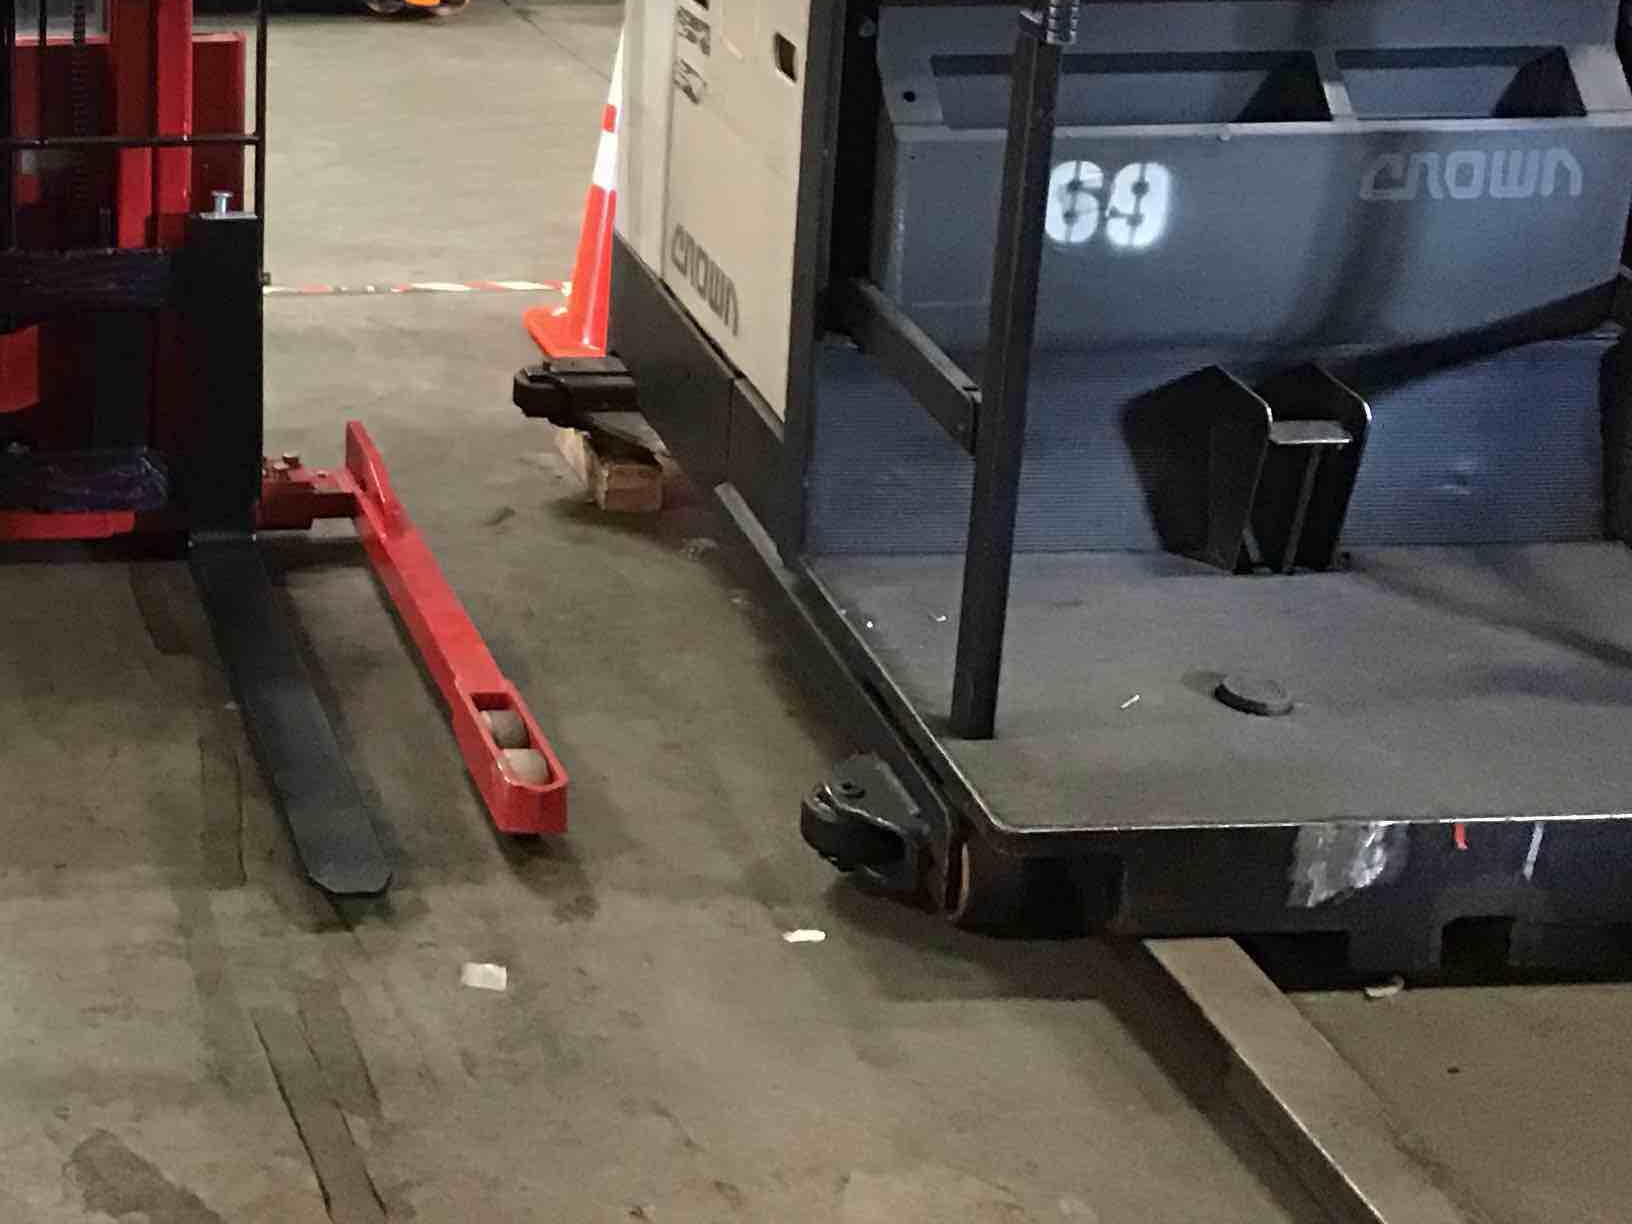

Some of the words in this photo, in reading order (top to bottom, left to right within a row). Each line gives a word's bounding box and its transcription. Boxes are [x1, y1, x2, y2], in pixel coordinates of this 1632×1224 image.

[1045, 160, 1170, 247] 69
[1360, 147, 1584, 200] CROWN
[671, 223, 739, 337] CROWN
